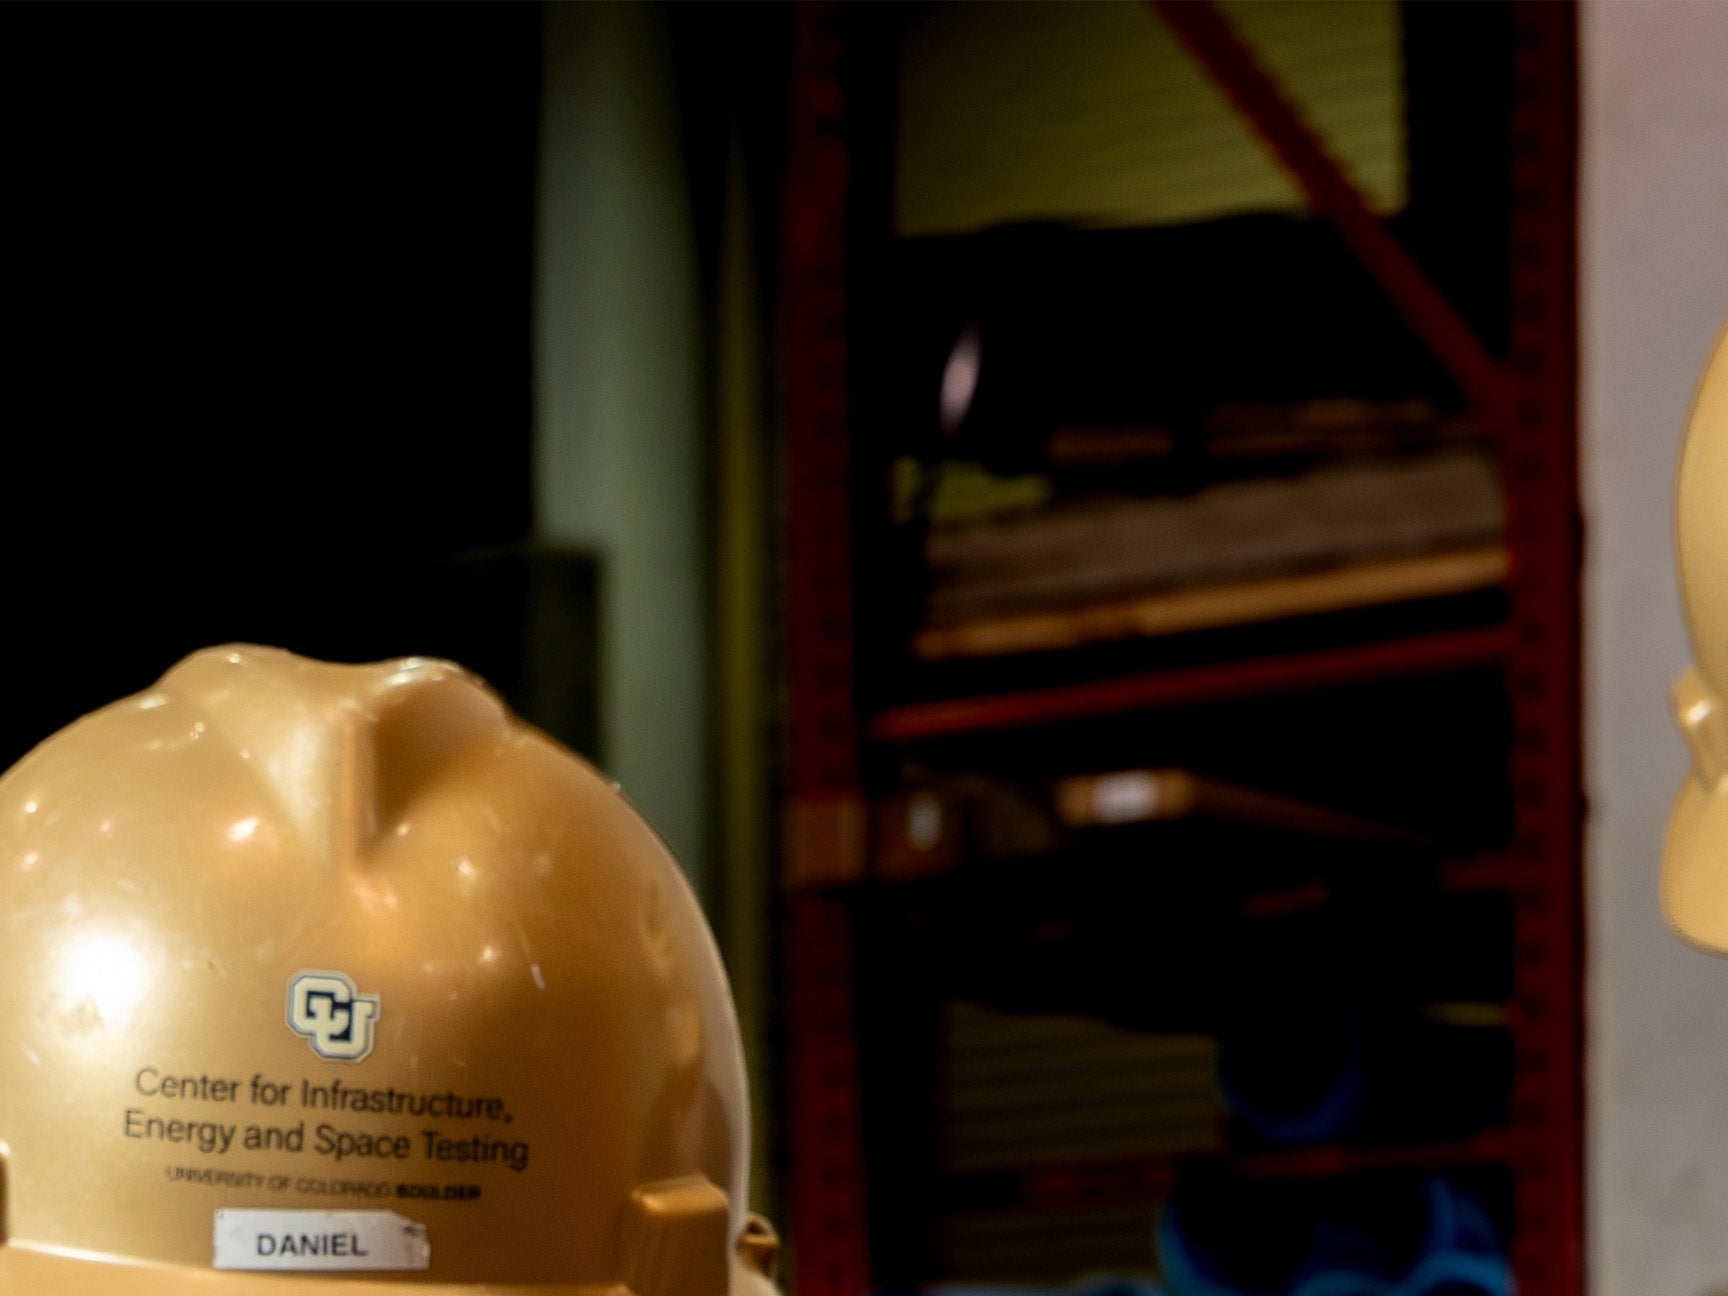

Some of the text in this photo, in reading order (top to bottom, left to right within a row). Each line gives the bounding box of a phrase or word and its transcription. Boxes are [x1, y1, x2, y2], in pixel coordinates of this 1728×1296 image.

[135, 1067, 515, 1124] Center for Infrastructure,
[124, 1108, 531, 1172] Energy and Space Testing
[255, 1232, 370, 1258] DANIEL
